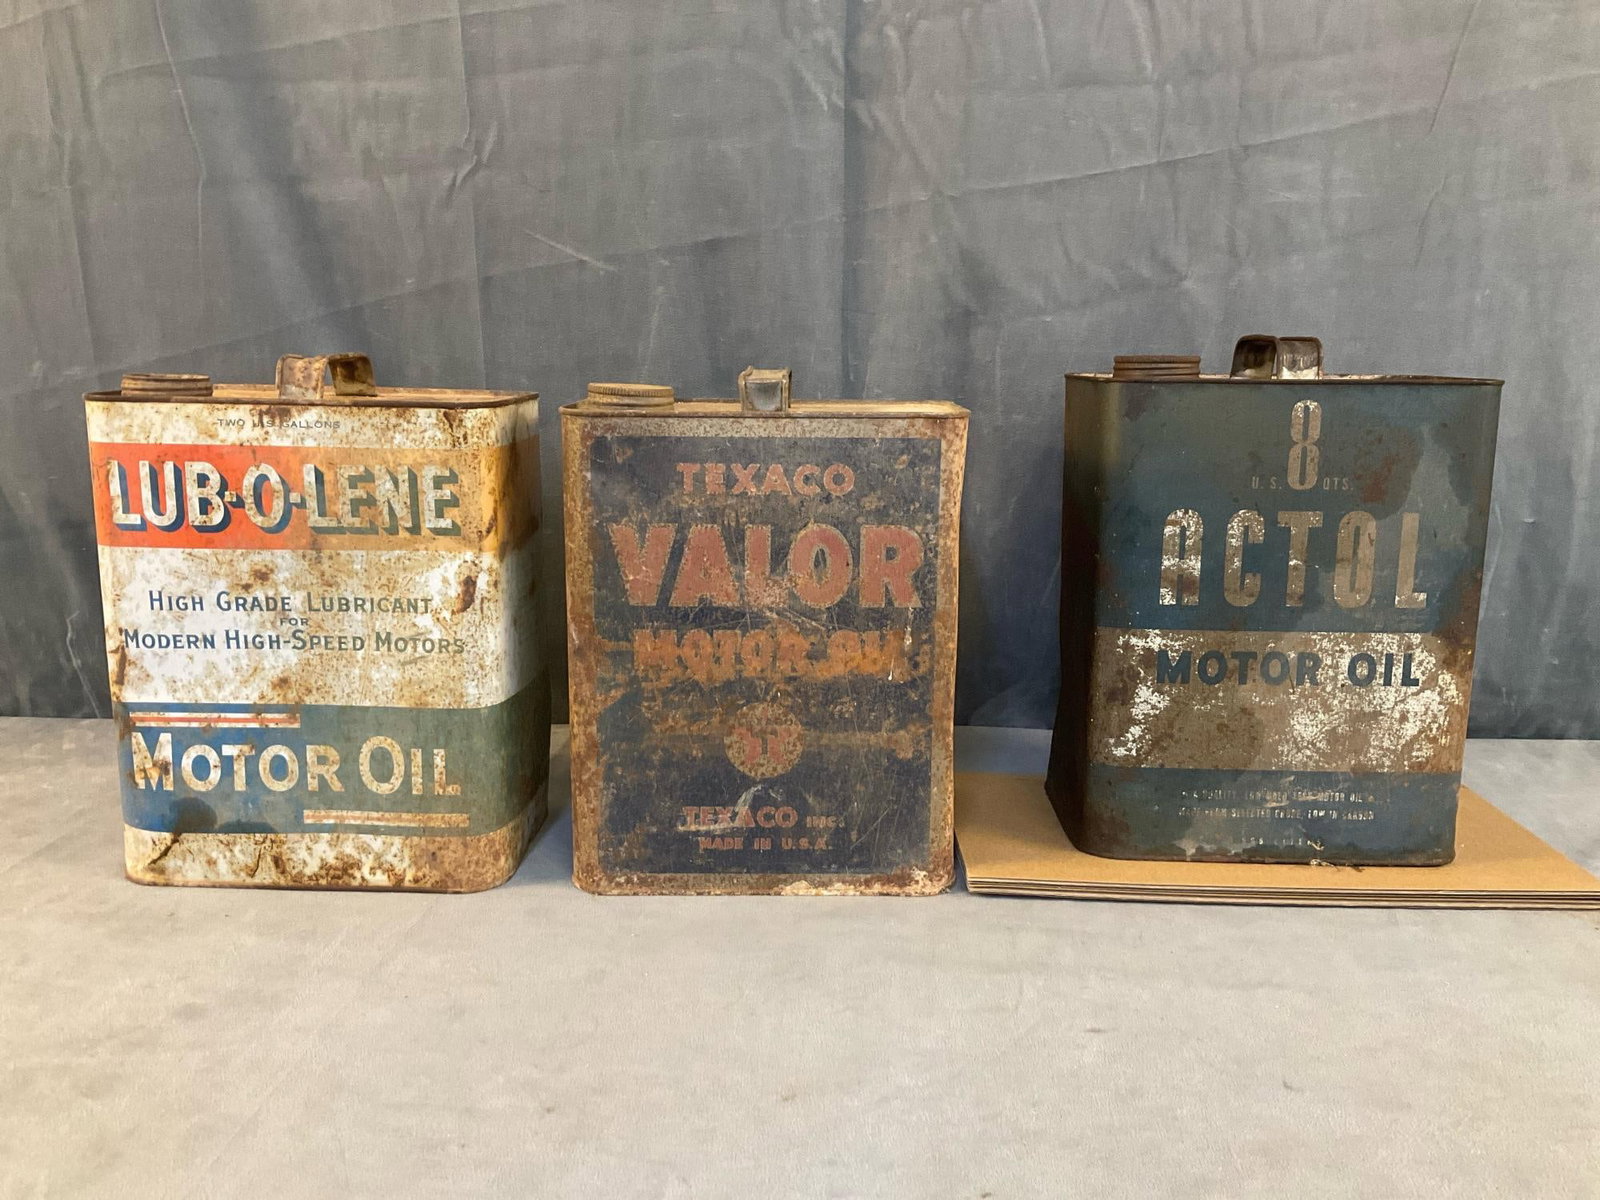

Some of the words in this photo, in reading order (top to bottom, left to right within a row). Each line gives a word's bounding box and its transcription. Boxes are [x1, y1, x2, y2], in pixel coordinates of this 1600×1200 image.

[217, 418, 246, 428] TWO
[281, 420, 341, 429] GALLONS
[1287, 399, 1322, 491] 8
[676, 462, 856, 497] TEXACO
[107, 459, 461, 536] LUB-O-LENE
[608, 522, 925, 609] VALOR
[1159, 508, 1428, 609] ACTOL
[148, 589, 204, 612] HIGH
[216, 590, 292, 613] GRADE
[307, 592, 433, 618] LUBRICANT
[279, 617, 309, 627] FOR
[124, 629, 216, 649] MODERN
[225, 629, 365, 652] HIGH-SPEED
[375, 632, 466, 655] MOTORS
[1155, 650, 1322, 687] MOTOR
[1347, 653, 1421, 688] OIL
[130, 732, 345, 793] MOTOR
[359, 735, 463, 796] OIL
[682, 805, 799, 828] TEXACO
[699, 837, 744, 850] MADE
[753, 837, 772, 850] IN
